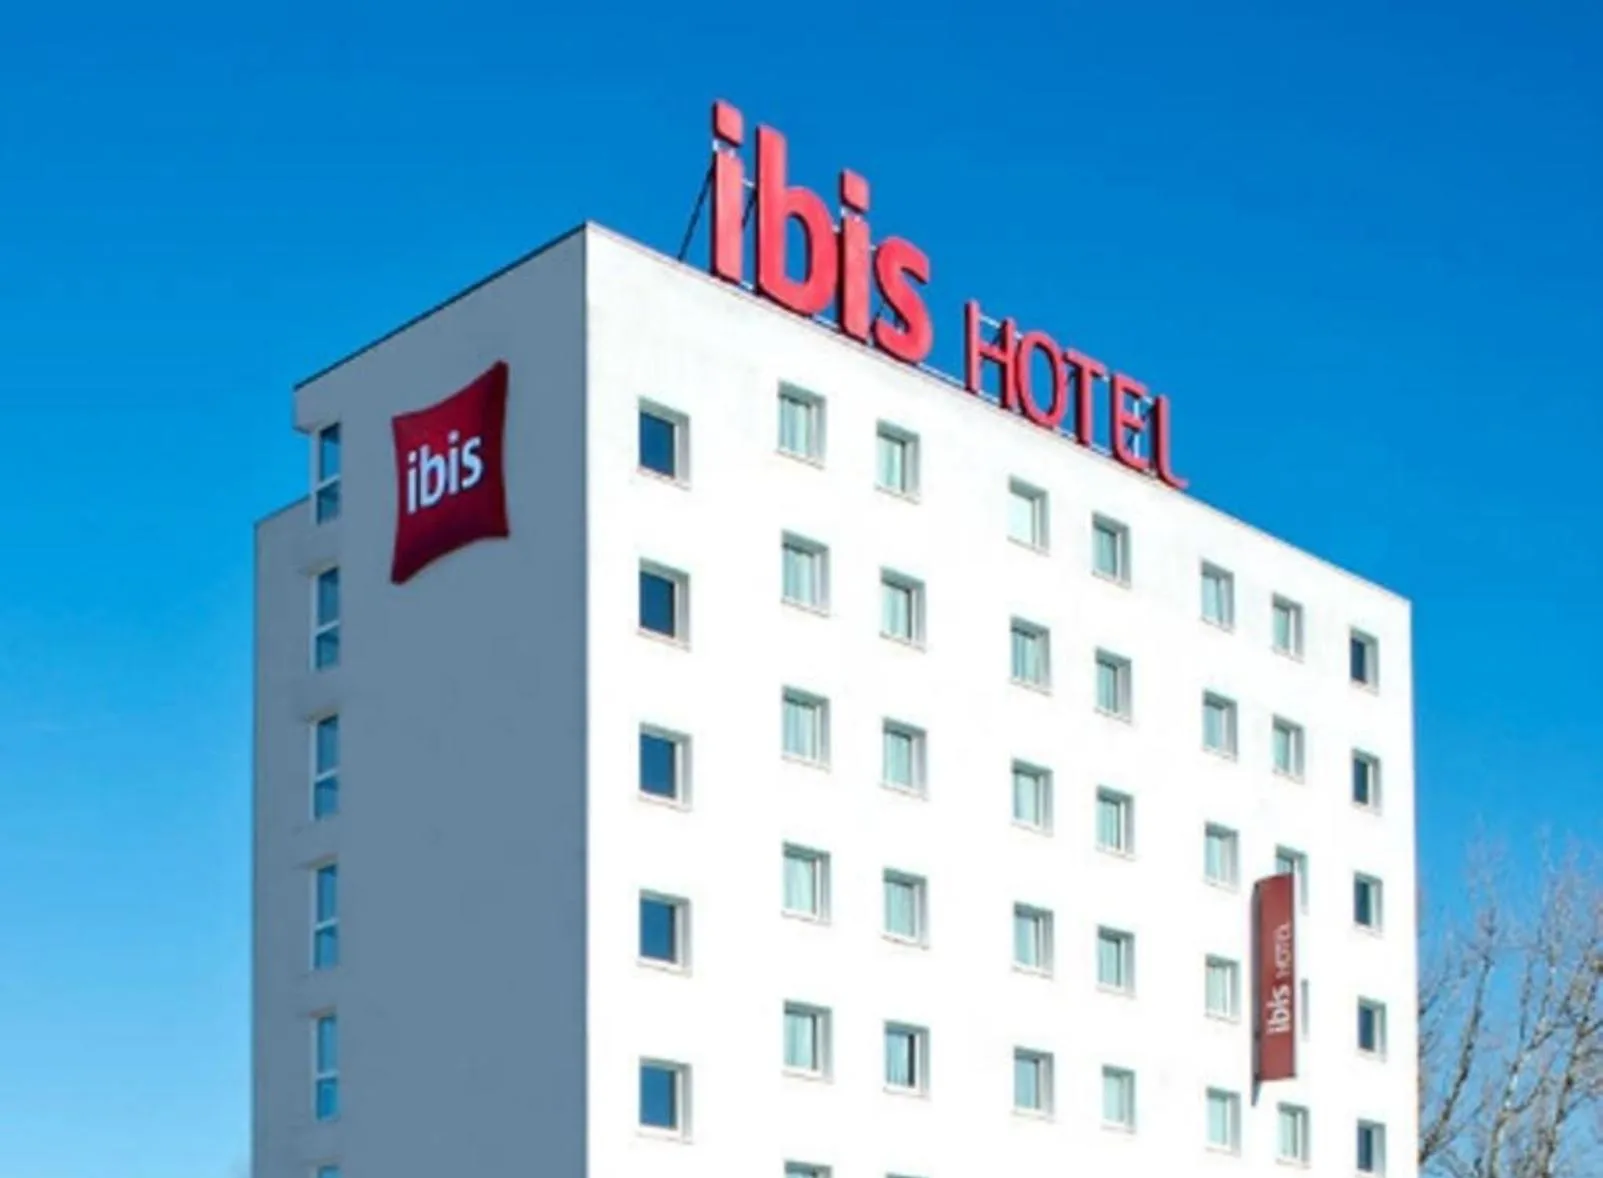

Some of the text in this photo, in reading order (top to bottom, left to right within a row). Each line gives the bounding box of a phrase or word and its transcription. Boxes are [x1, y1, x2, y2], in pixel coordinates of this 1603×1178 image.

[711, 99, 1188, 490] ibis HOTEL
[407, 430, 484, 514] ibis
[1266, 984, 1292, 1034] ibis
